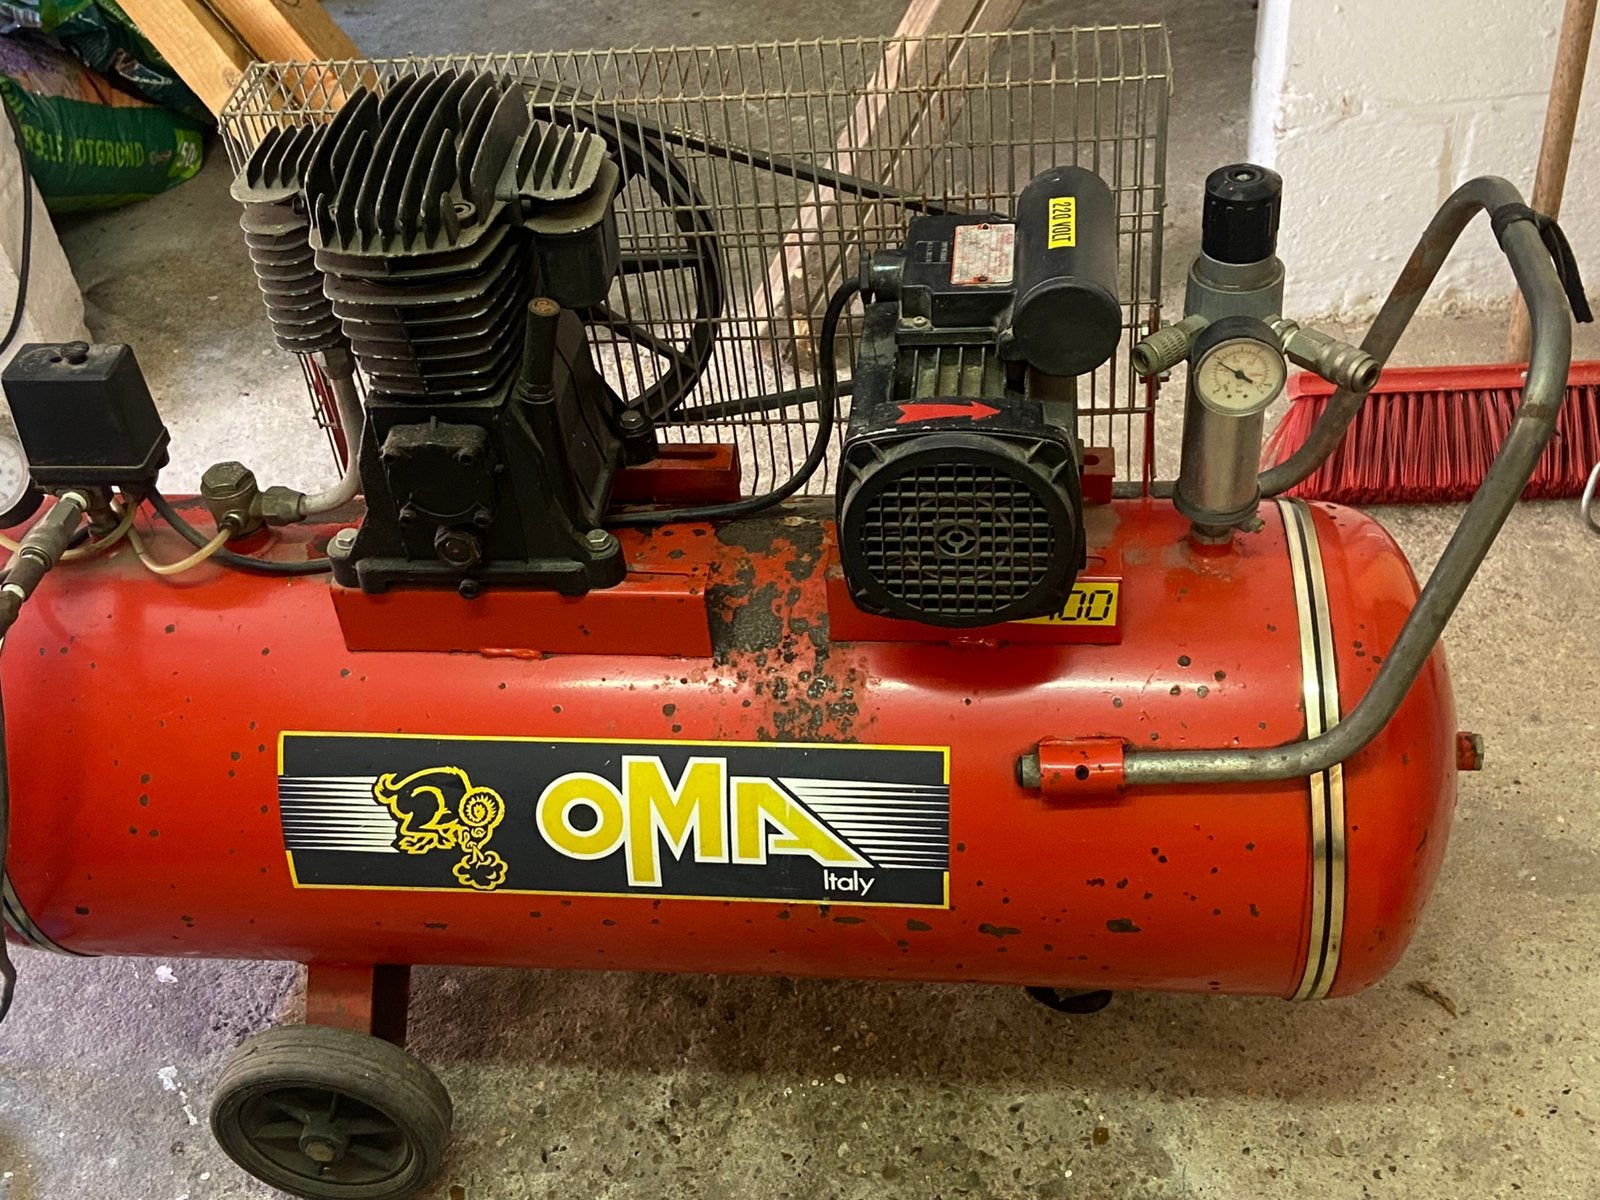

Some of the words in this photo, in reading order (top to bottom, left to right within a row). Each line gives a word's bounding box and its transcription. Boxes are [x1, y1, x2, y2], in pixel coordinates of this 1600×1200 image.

[70, 138, 144, 168] OTGROND
[1052, 201, 1072, 220] 220
[1051, 221, 1072, 242] VOLT
[1048, 589, 1114, 622] 00
[535, 754, 875, 888] OMA
[823, 869, 876, 896] Italy
